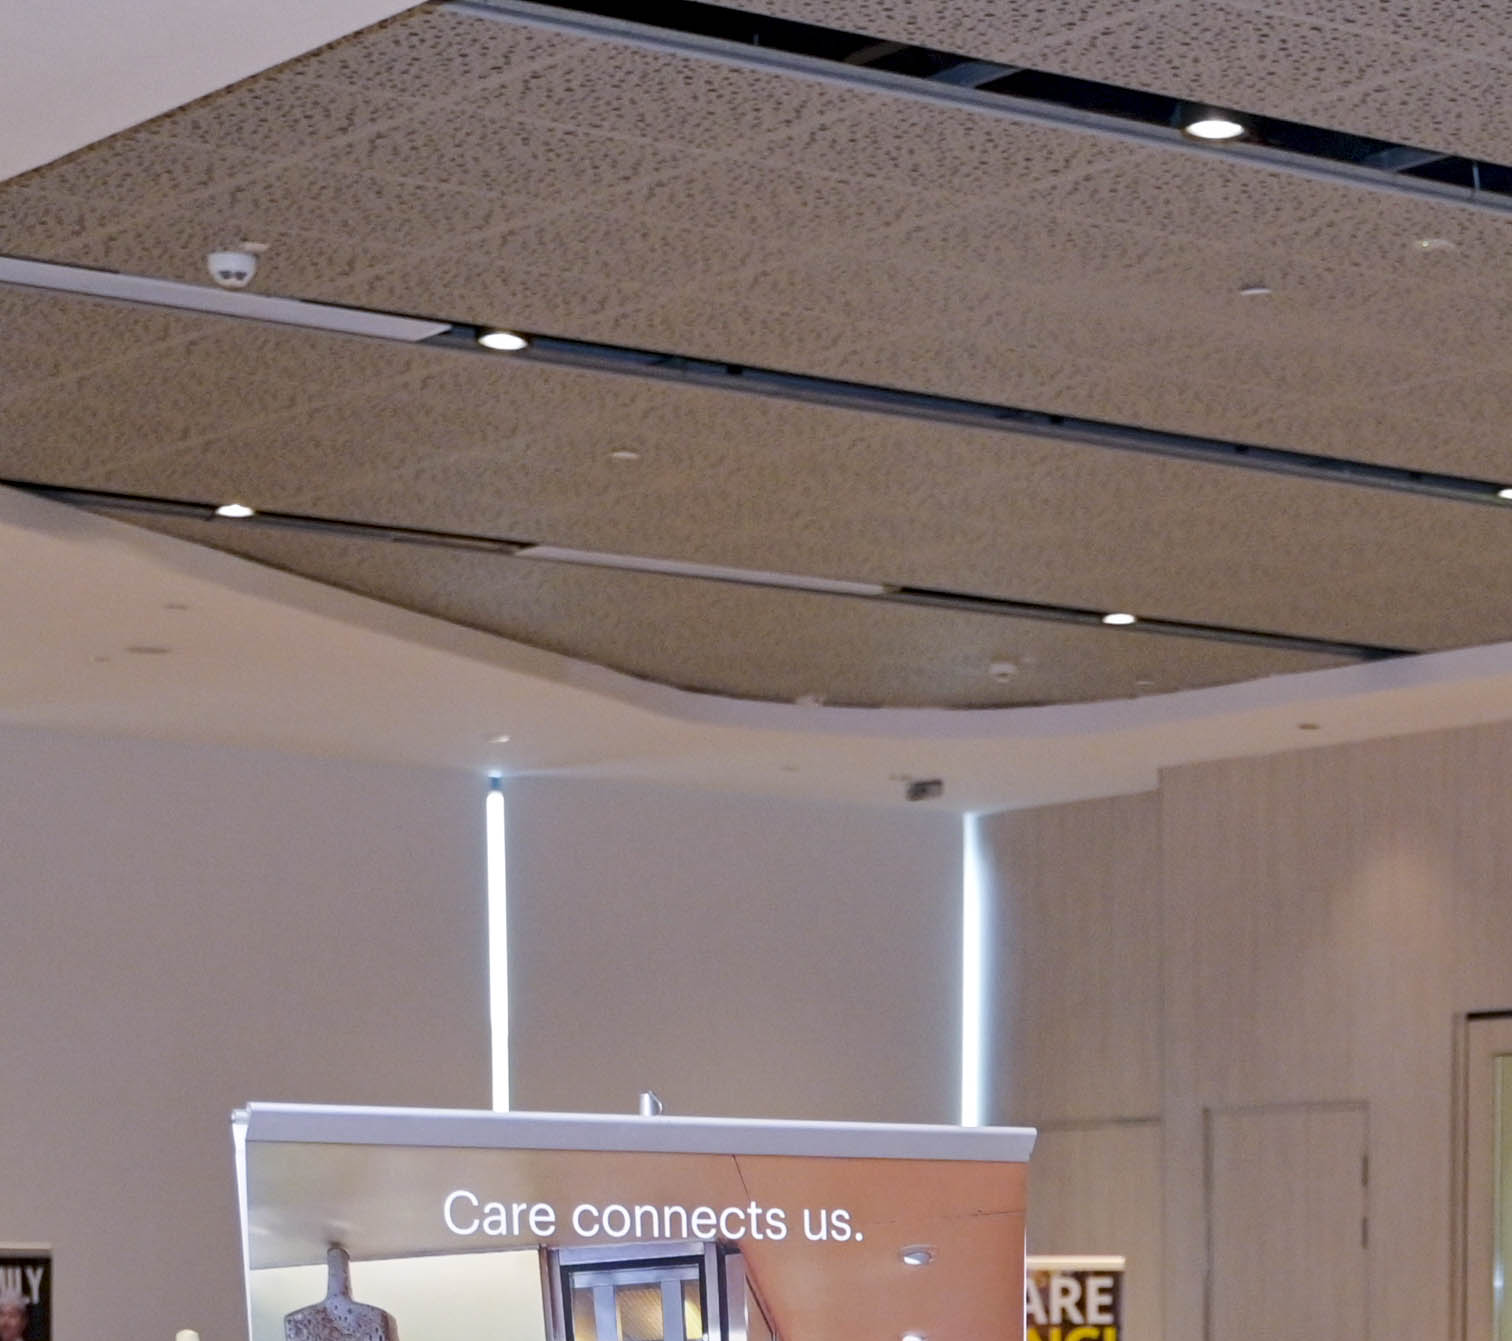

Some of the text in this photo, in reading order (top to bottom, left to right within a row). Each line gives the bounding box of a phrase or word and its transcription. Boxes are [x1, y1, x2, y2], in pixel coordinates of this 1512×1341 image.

[444, 1189, 864, 1242] Care connects us.
